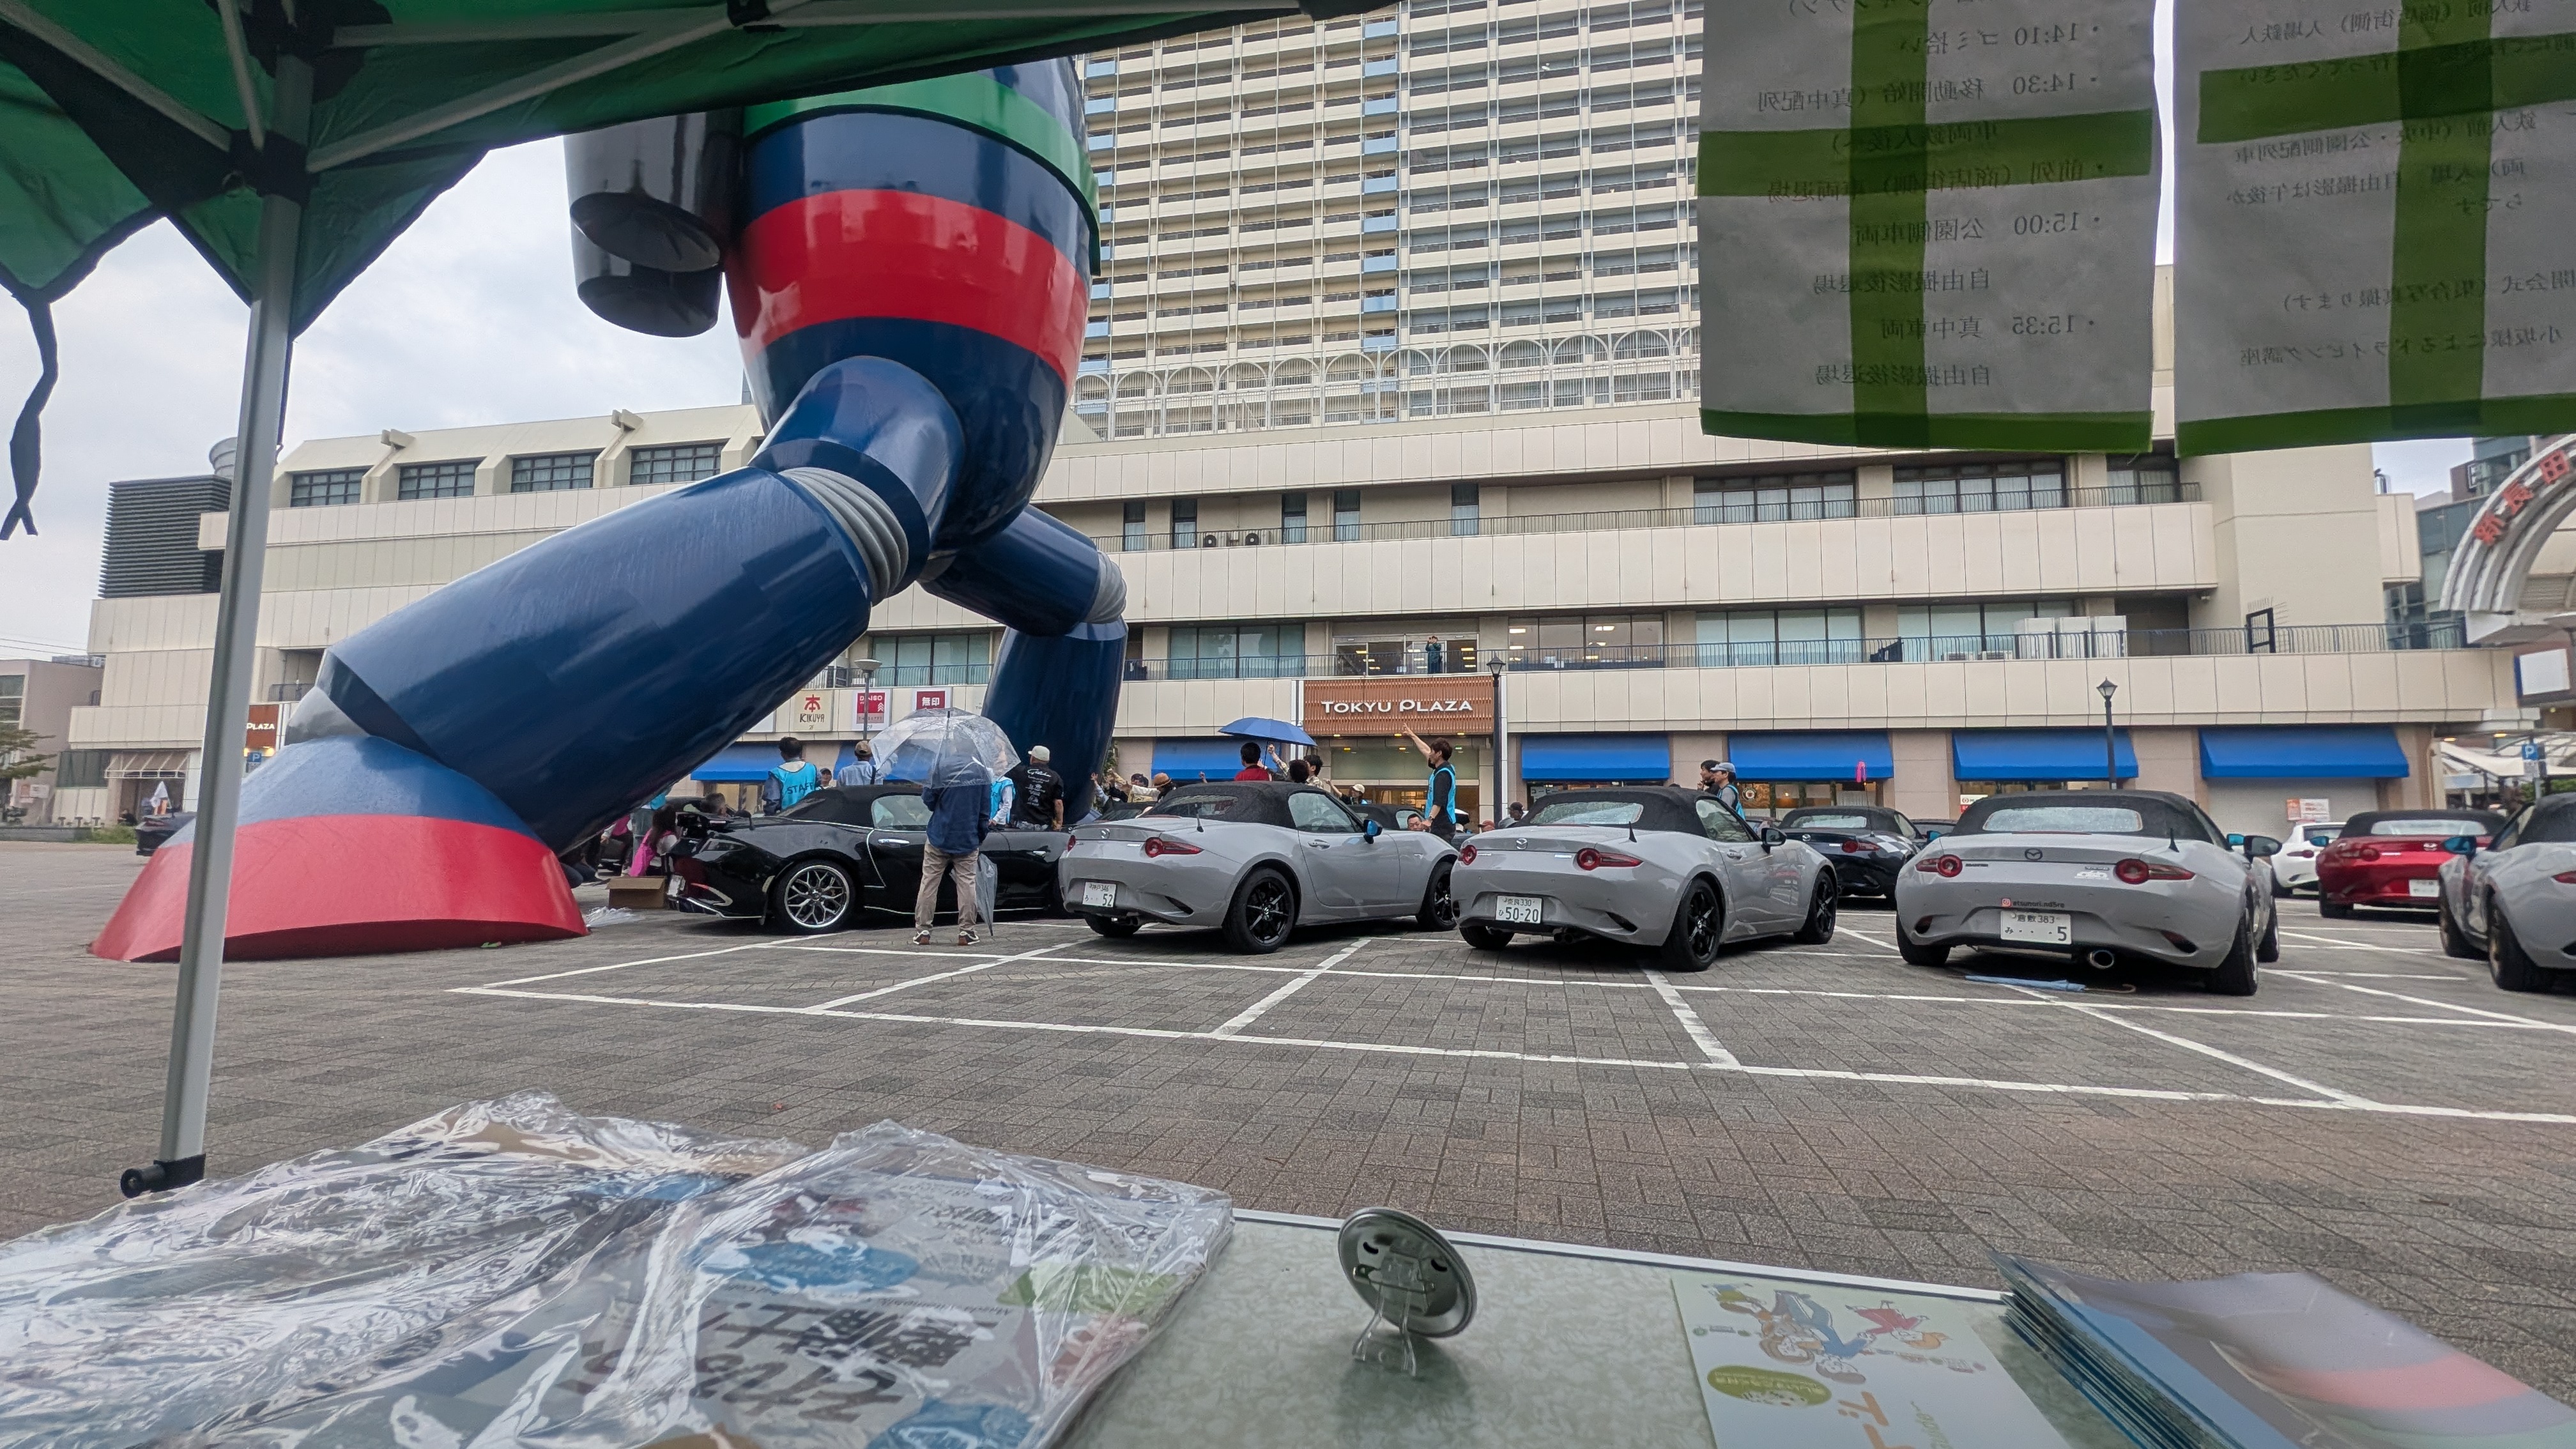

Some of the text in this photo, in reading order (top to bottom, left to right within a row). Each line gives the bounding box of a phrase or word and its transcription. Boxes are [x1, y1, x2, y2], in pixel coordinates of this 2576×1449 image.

[922, 696, 940, 707] 無印
[1321, 699, 1473, 714] TOKYU PLAZA
[799, 713, 825, 723] KIKUYA
[246, 722, 275, 730] PLAZA
[786, 782, 813, 795] STAFF
